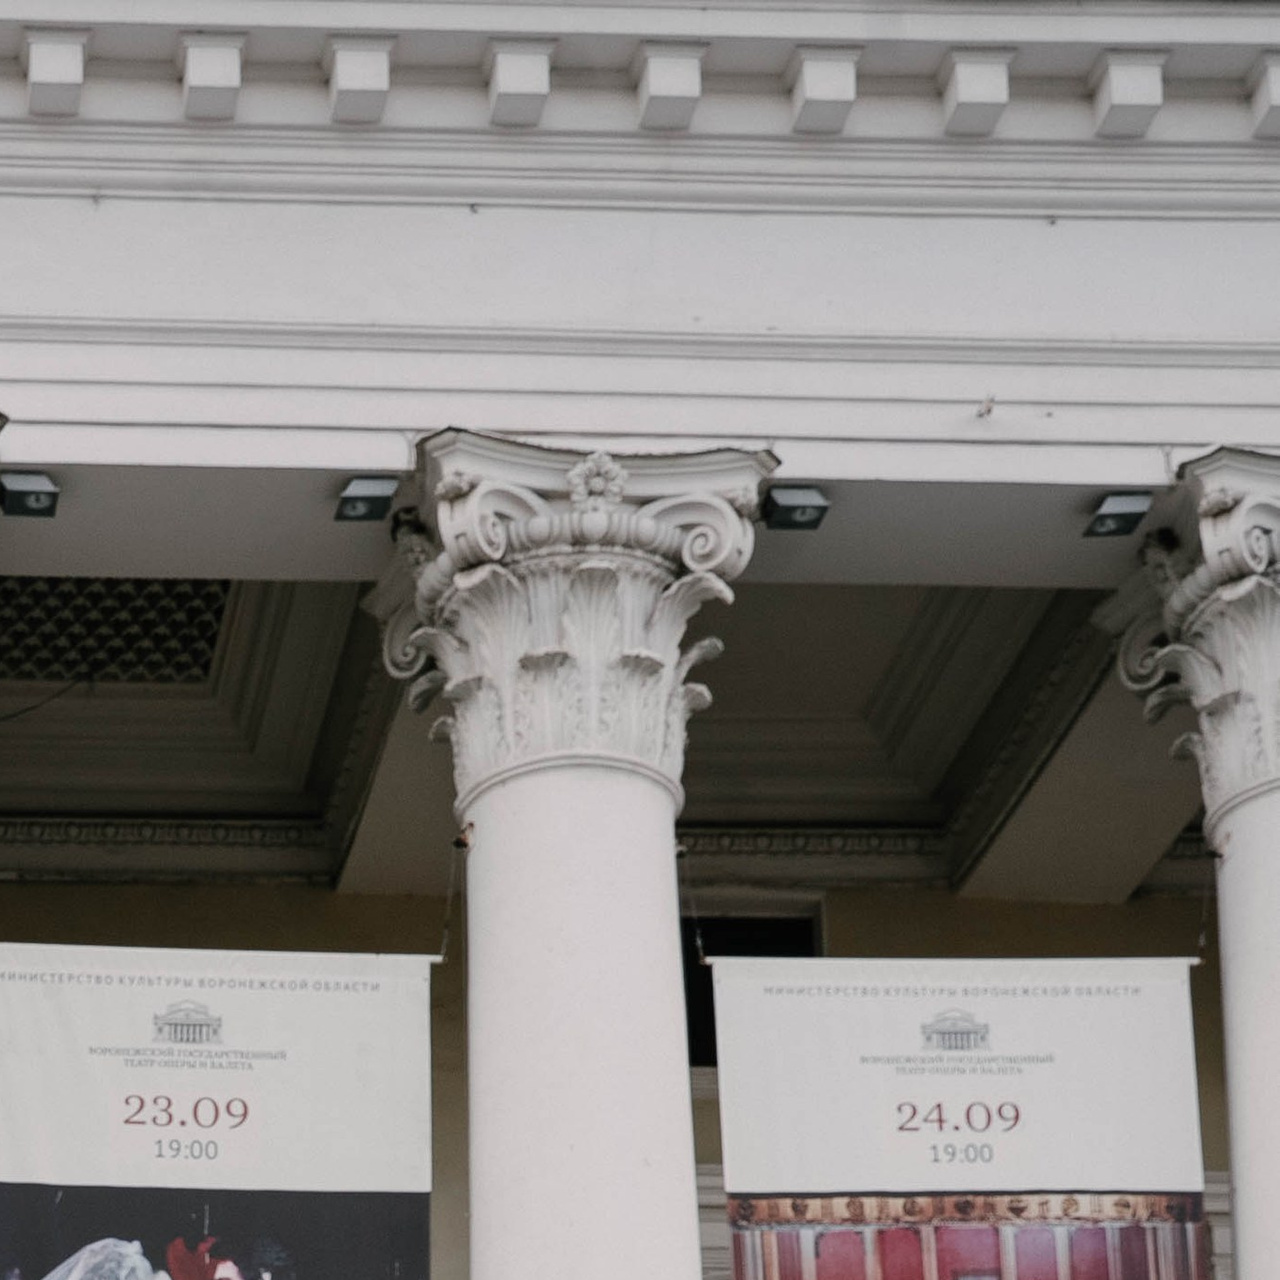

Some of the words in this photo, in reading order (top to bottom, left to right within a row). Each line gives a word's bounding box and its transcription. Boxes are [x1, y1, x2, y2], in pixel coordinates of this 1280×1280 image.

[119, 974, 193, 987] КУЛЬТУРЫ
[198, 977, 308, 991] ВОРОНЕЖСКОЙ
[312, 980, 380, 992] ОБЛАСТИ
[123, 1094, 249, 1129] 23.09
[896, 1101, 1020, 1133] 24.09
[154, 1138, 218, 1160] 19:00
[930, 1142, 994, 1163] 19:00
